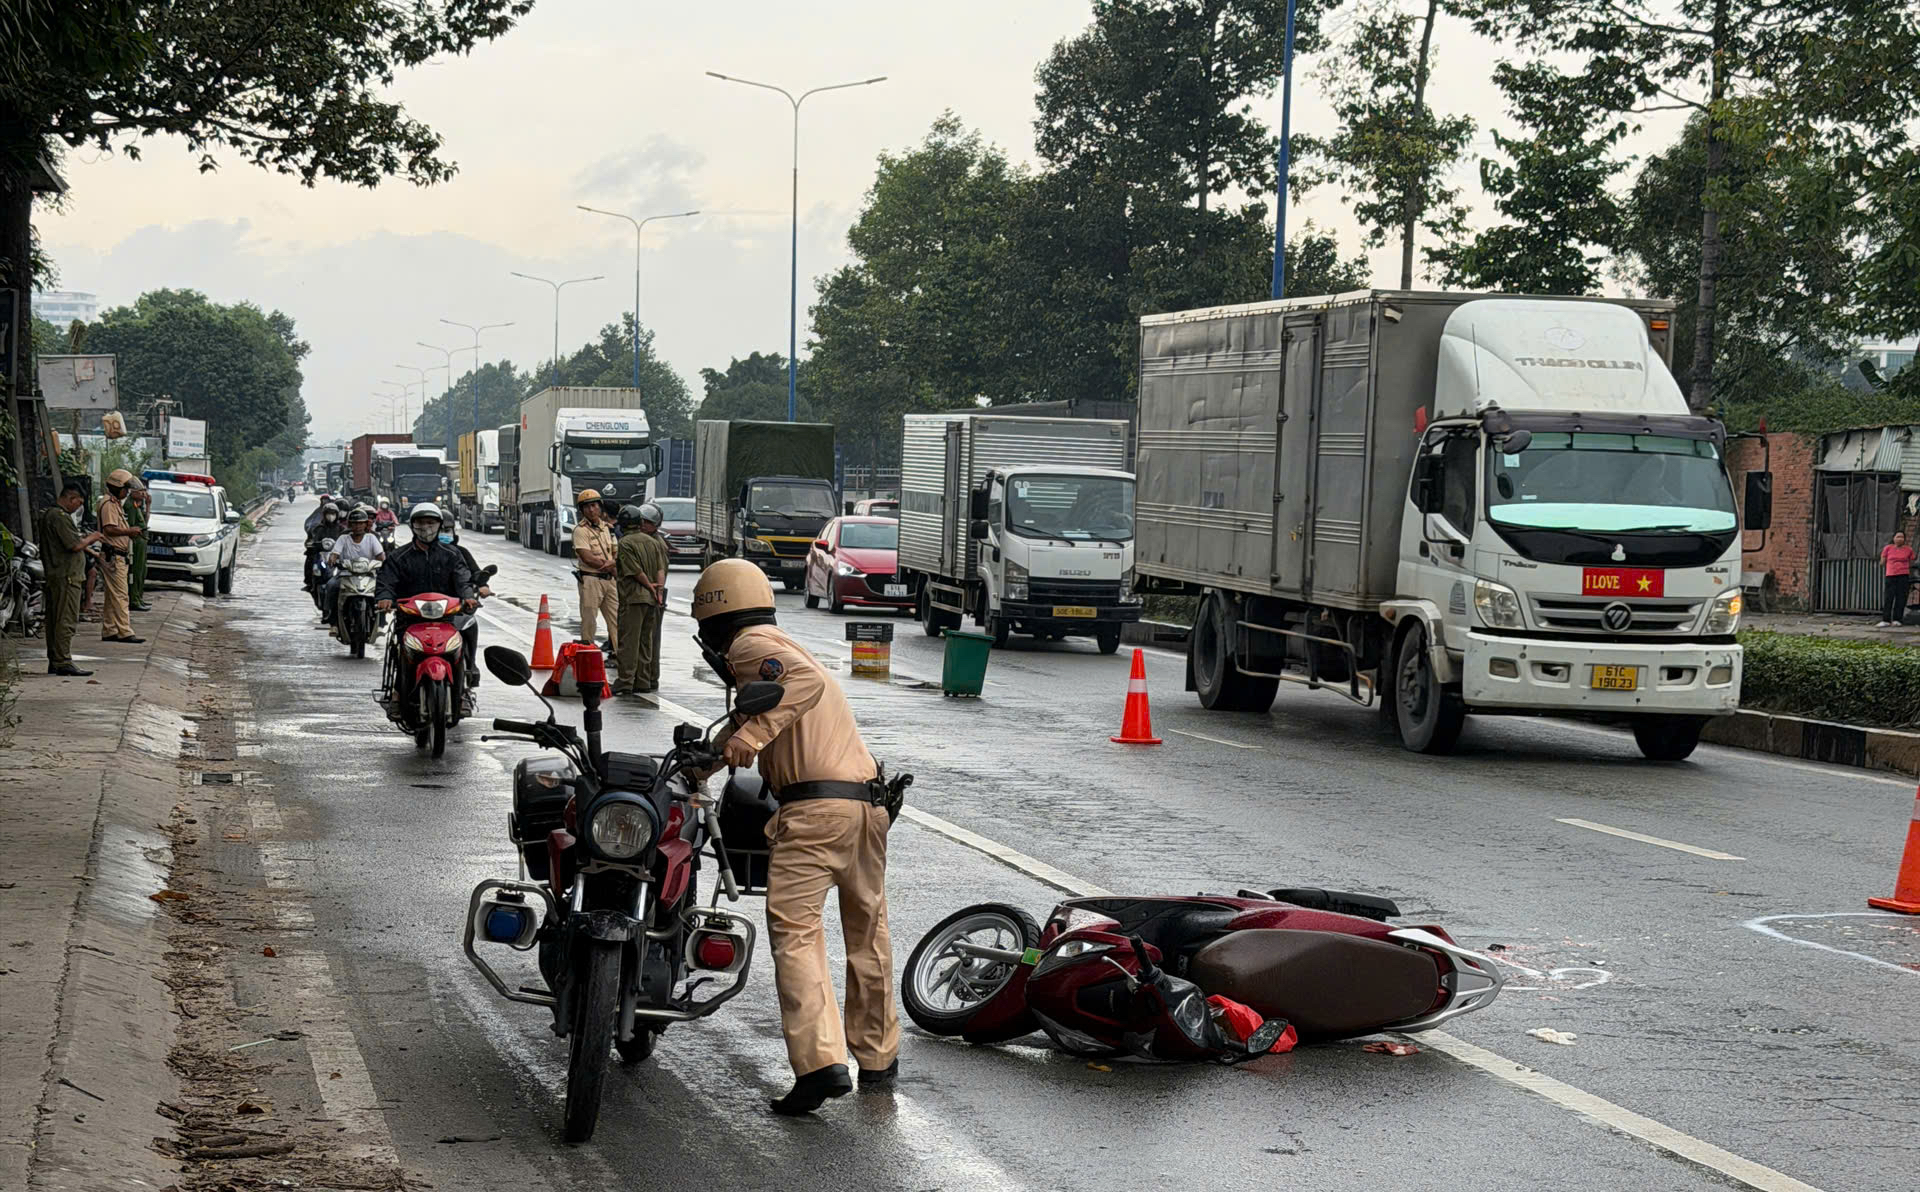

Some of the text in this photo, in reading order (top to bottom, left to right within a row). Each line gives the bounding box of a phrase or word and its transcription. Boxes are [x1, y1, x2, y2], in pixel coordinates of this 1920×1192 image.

[585, 421, 630, 430] CHENGLONG
[1059, 569, 1092, 577] ISUZU
[1585, 575, 1621, 590] I LOVE
[1606, 666, 1625, 677] 61C
